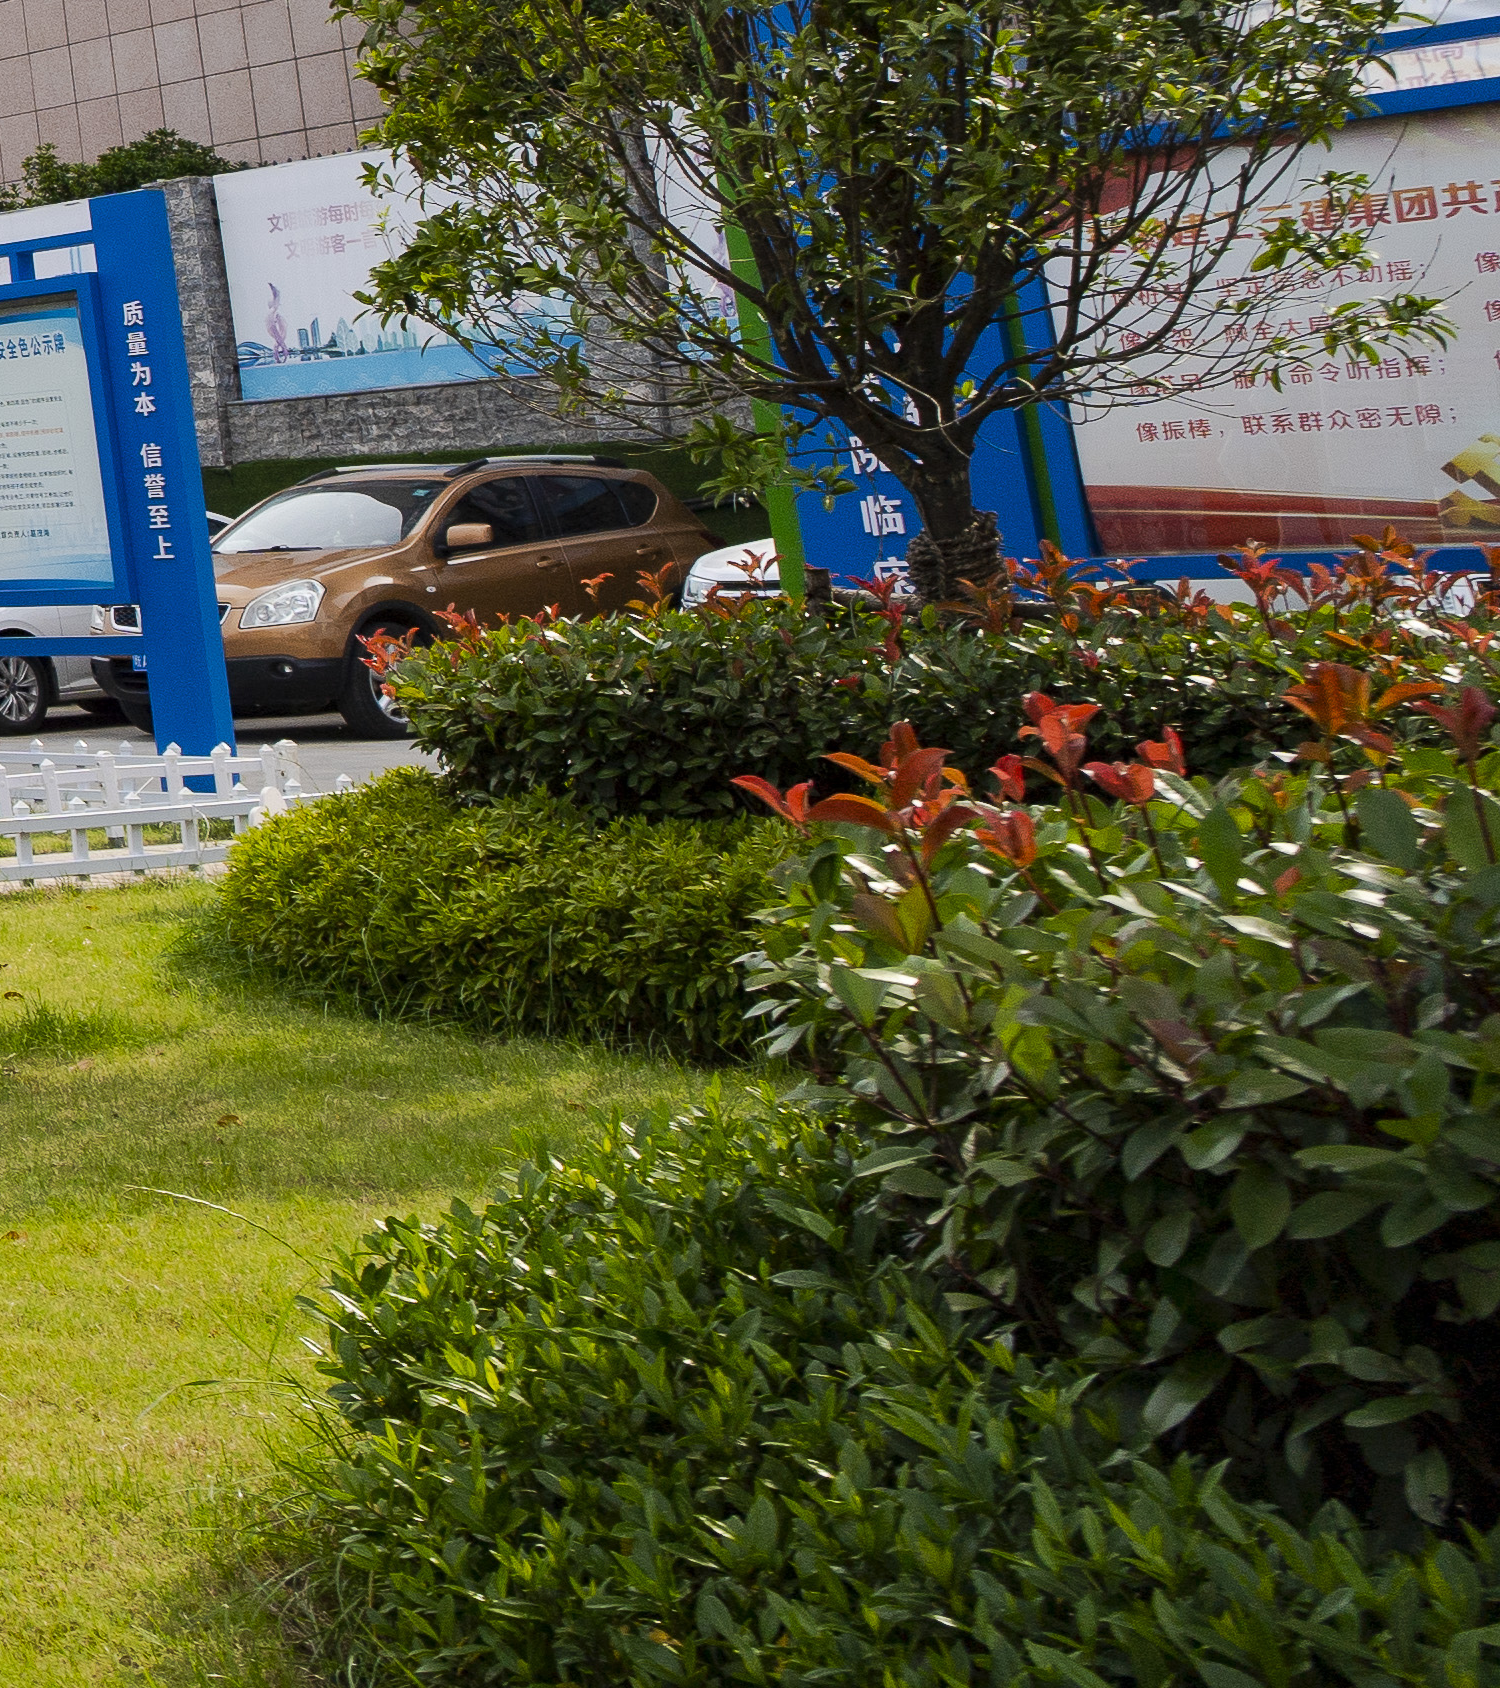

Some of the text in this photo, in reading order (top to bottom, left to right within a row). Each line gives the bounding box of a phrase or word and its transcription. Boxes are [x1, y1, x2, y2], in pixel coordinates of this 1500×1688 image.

[122, 300, 175, 560] 质量为本 信誉至上
